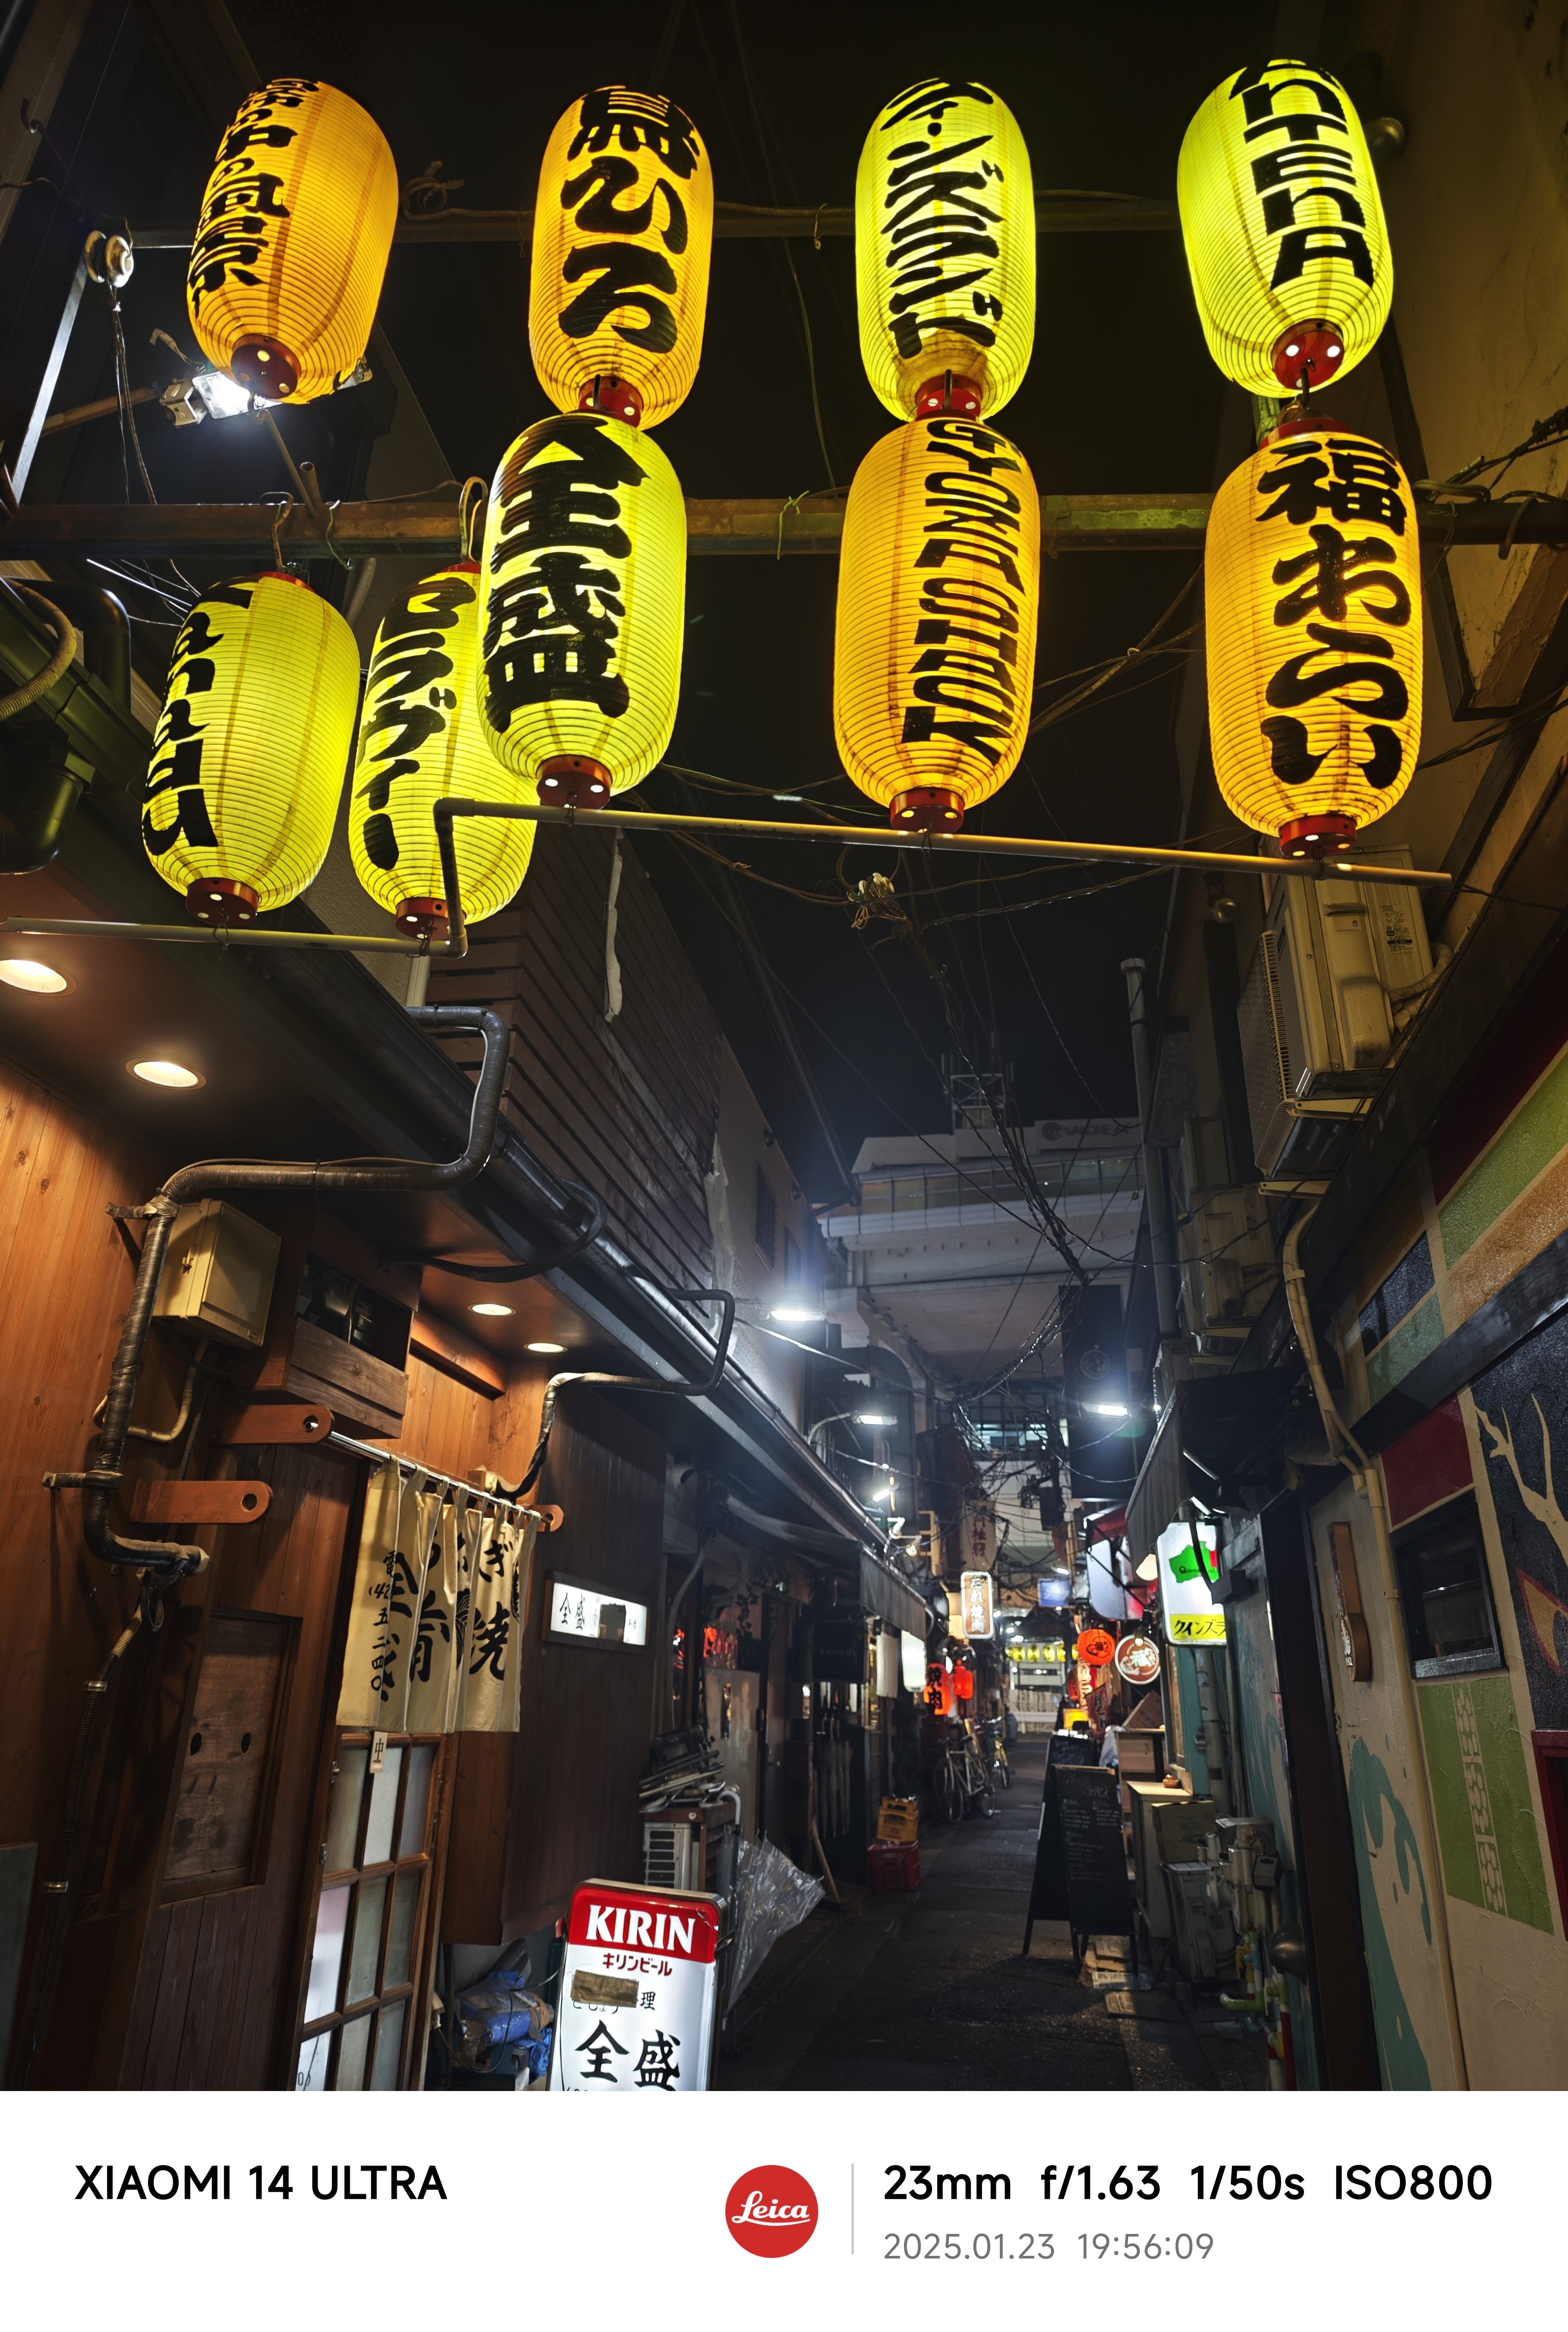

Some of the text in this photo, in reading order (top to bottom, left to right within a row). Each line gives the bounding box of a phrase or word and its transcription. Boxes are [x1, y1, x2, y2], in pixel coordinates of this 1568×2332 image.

[558, 86, 700, 354] 鳥ひろ
[483, 414, 651, 733] 全盛
[1256, 439, 1411, 790] 福わらい
[559, 1592, 585, 1631] 全盛
[585, 1904, 696, 1954] KIRIN
[602, 1952, 672, 1977] キリンビール
[574, 2019, 681, 2091] 全盛
